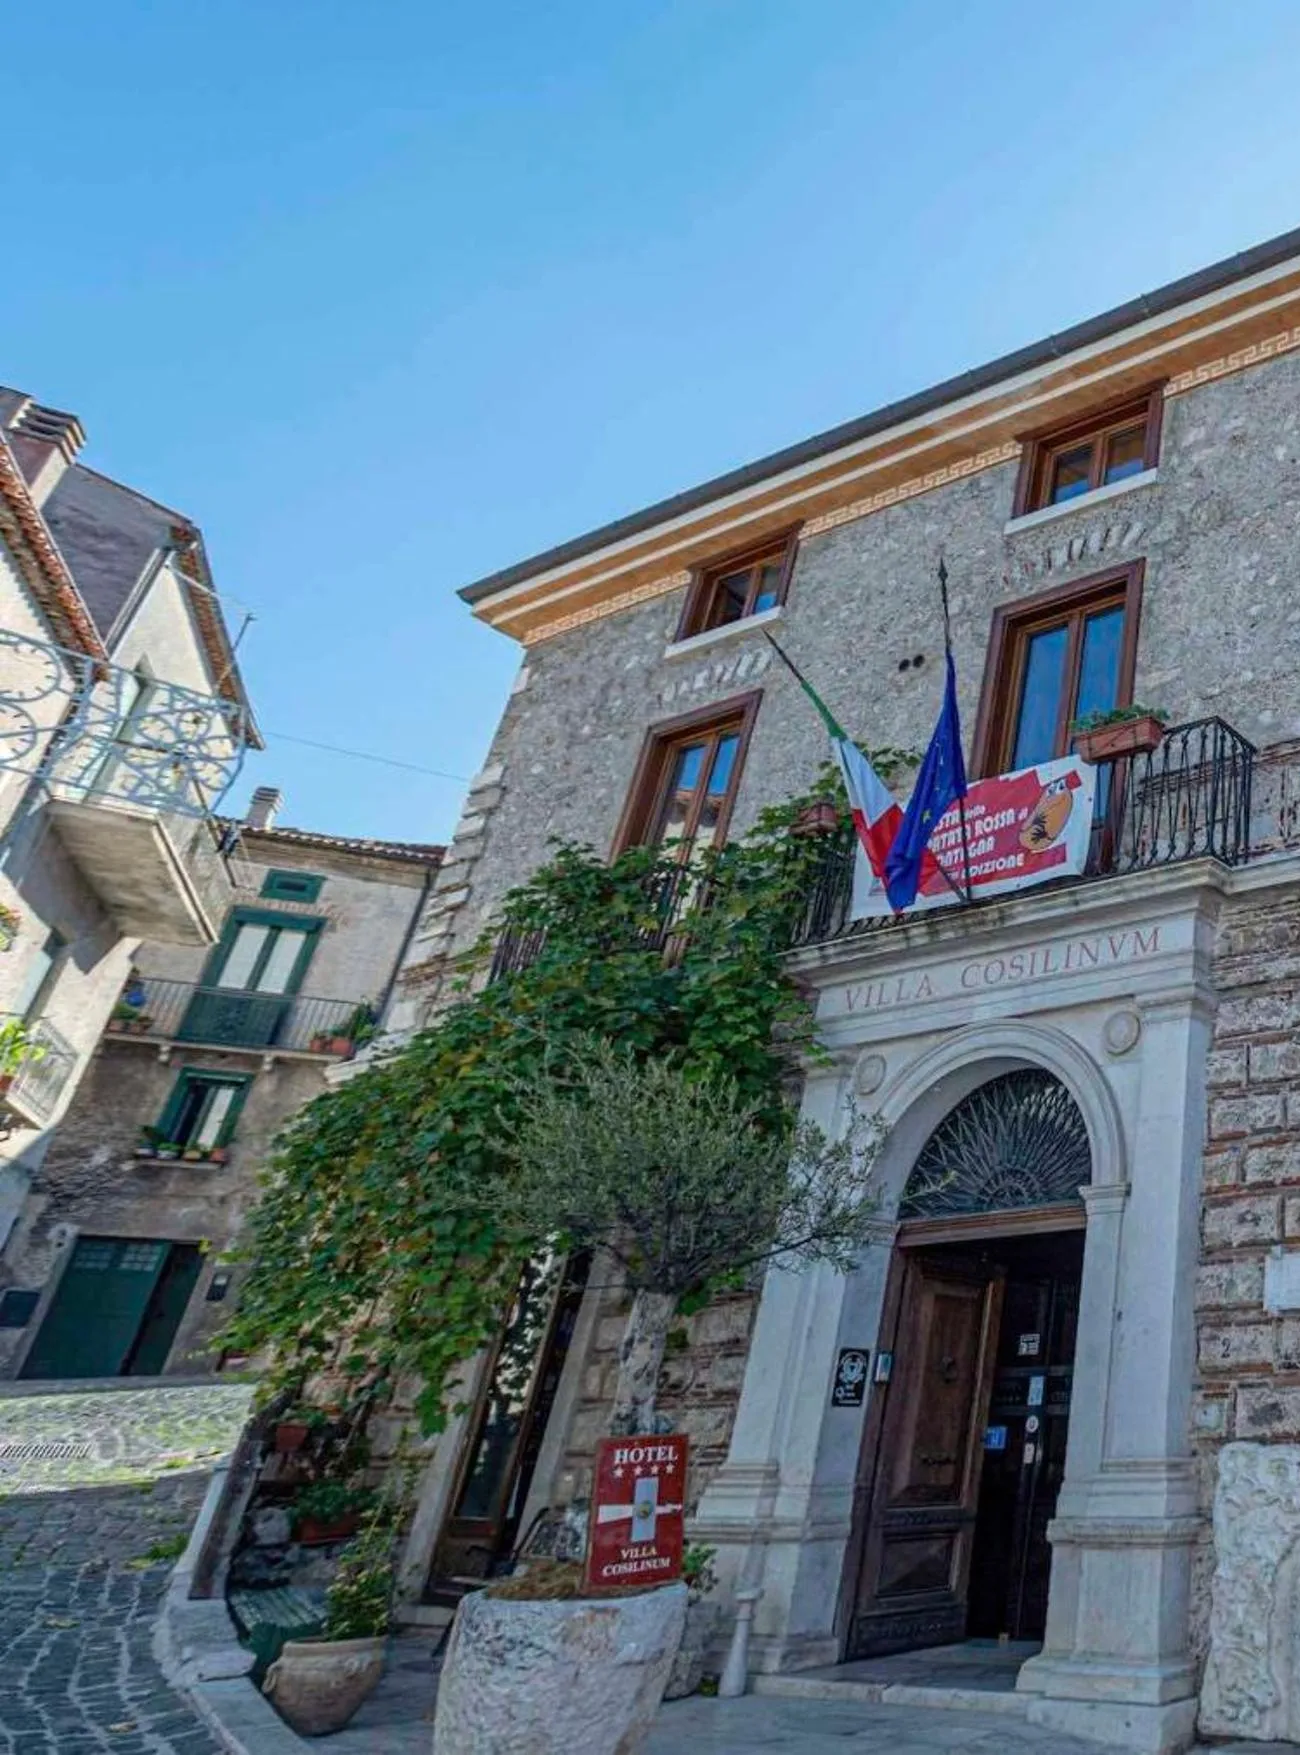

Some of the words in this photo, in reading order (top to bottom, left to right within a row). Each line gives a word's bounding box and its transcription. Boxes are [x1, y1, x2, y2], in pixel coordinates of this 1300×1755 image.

[974, 808, 1015, 837] ROSSA
[844, 973, 934, 1011] VILLA
[960, 926, 1162, 989] COSILINVM
[613, 1446, 679, 1465] HOTEL
[620, 1547, 658, 1560] VILLA
[602, 1557, 671, 1578] COSILINUM
